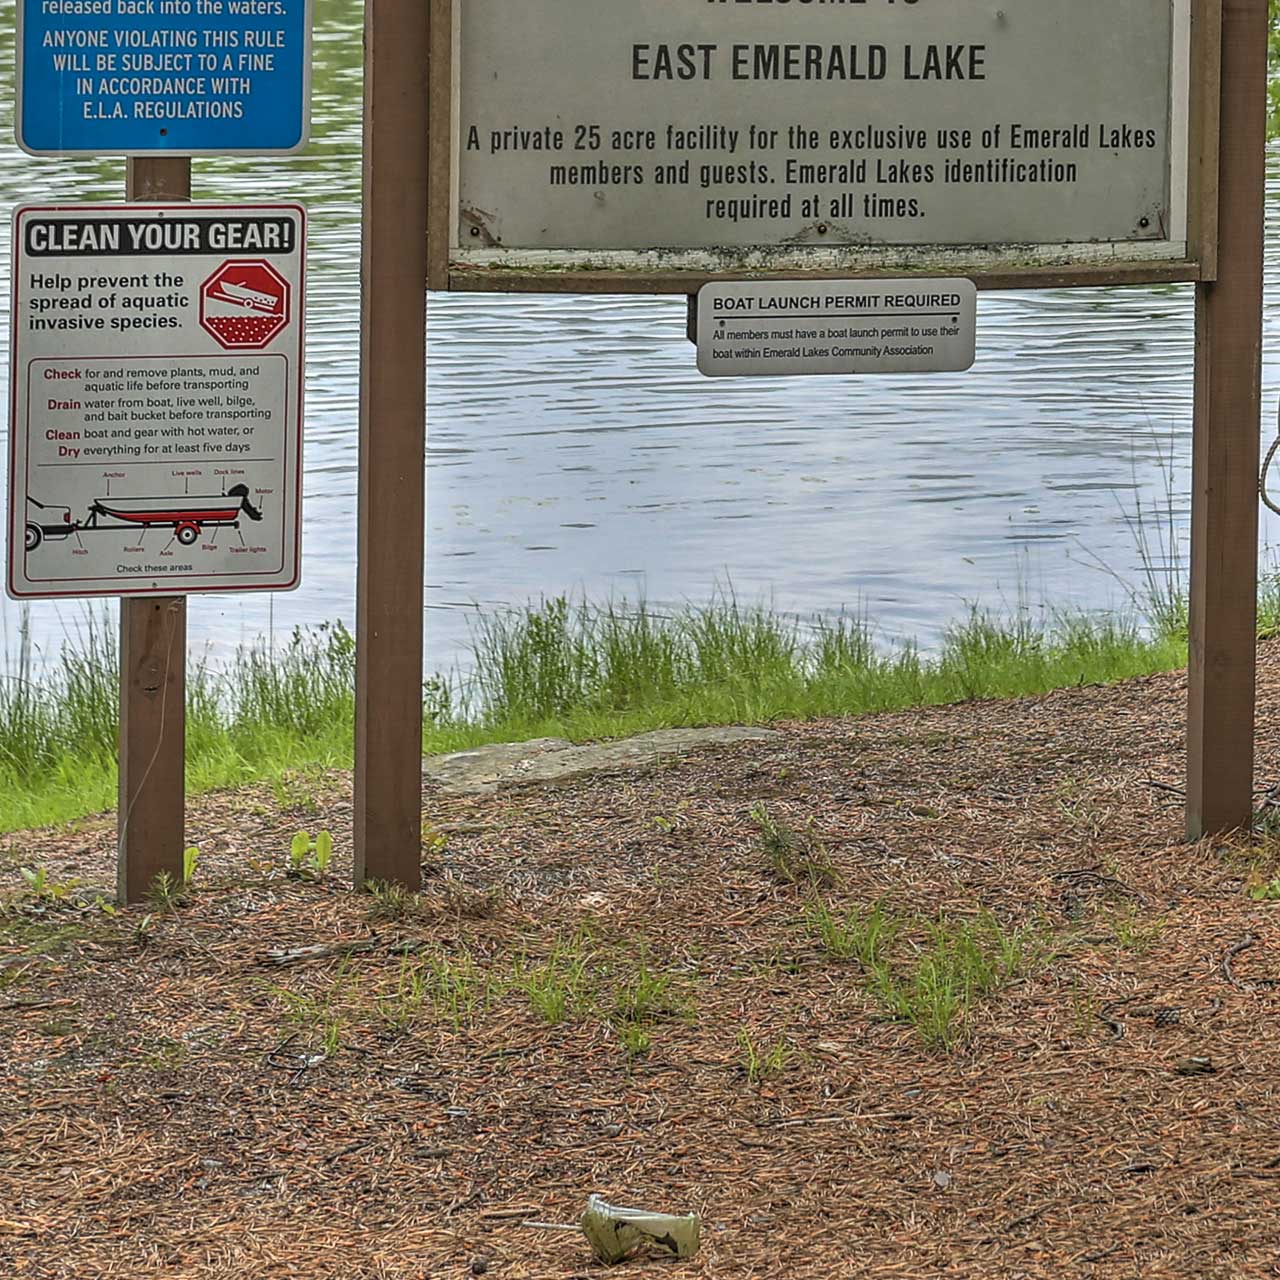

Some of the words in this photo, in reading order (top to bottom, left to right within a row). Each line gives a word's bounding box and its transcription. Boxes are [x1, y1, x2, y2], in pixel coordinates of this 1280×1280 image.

[42, 30, 108, 47] ANYONE
[113, 30, 197, 47] VIOLATING
[202, 30, 238, 47] THIS
[244, 30, 284, 47] RULE
[53, 54, 90, 71] WILL
[96, 54, 116, 71] BE
[121, 53, 192, 71] SUBJECT
[197, 53, 217, 71] TO
[222, 54, 232, 70] A
[238, 54, 274, 71] FINE
[632, 44, 717, 80] EAST
[732, 44, 886, 80] EMERALD
[903, 44, 985, 80] LAKE
[77, 78, 92, 94] IN
[98, 77, 205, 94] ACCORDANCE
[211, 77, 250, 94] WITH
[83, 101, 127, 118] E.L.A.
[134, 101, 243, 118] REGULATIONS
[466, 125, 480, 150] A
[491, 125, 563, 154] private
[574, 124, 600, 150] 25
[611, 130, 655, 149] acre
[666, 124, 738, 153] facility
[749, 124, 778, 149] for
[788, 124, 818, 149] the
[829, 124, 926, 149] exclusive
[937, 130, 971, 148] use
[982, 124, 1000, 148] of
[1010, 123, 1089, 148] Emerald
[1100, 124, 1157, 150] Lakes
[550, 159, 643, 184] members
[654, 159, 689, 184] and
[700, 160, 774, 188] guests.
[786, 158, 865, 183] Emerald
[876, 158, 933, 183] Lakes
[944, 158, 1076, 183] identification
[706, 193, 790, 222] required
[801, 194, 819, 218] at
[824, 193, 853, 218] all
[863, 192, 924, 217] times.
[30, 224, 119, 250] CLEAN
[127, 223, 200, 249] YOUR
[208, 222, 289, 248] GEAR!
[30, 273, 71, 292] Help
[77, 274, 148, 292] prevent
[153, 272, 183, 287] the
[29, 293, 91, 312] spread
[98, 292, 116, 308] of
[121, 292, 188, 311] aquatic
[713, 297, 754, 310] BOAT
[758, 296, 820, 309] LAUNCH
[825, 295, 880, 308] PERMIT
[884, 293, 960, 307] REQUIRED
[29, 314, 104, 330] invasive
[110, 313, 182, 331] species.
[712, 329, 724, 340] All
[726, 329, 769, 340] members
[770, 329, 793, 339] must
[795, 328, 817, 339] have
[819, 330, 825, 338] a
[827, 328, 847, 338] boat
[849, 327, 879, 338] launch
[880, 326, 909, 339] permit
[910, 327, 919, 336] to
[921, 328, 938, 336] use
[939, 325, 960, 336] their
[43, 368, 81, 379] Check
[84, 368, 100, 378] for
[103, 367, 123, 378] and
[126, 369, 167, 377] remove
[239, 365, 259, 375] and
[47, 398, 81, 410] Drain
[83, 399, 115, 408] water
[117, 397, 143, 408] from
[176, 396, 195, 407] live
[226, 395, 257, 409] bilge,
[116, 564, 142, 573] Check
[144, 564, 167, 572] these
